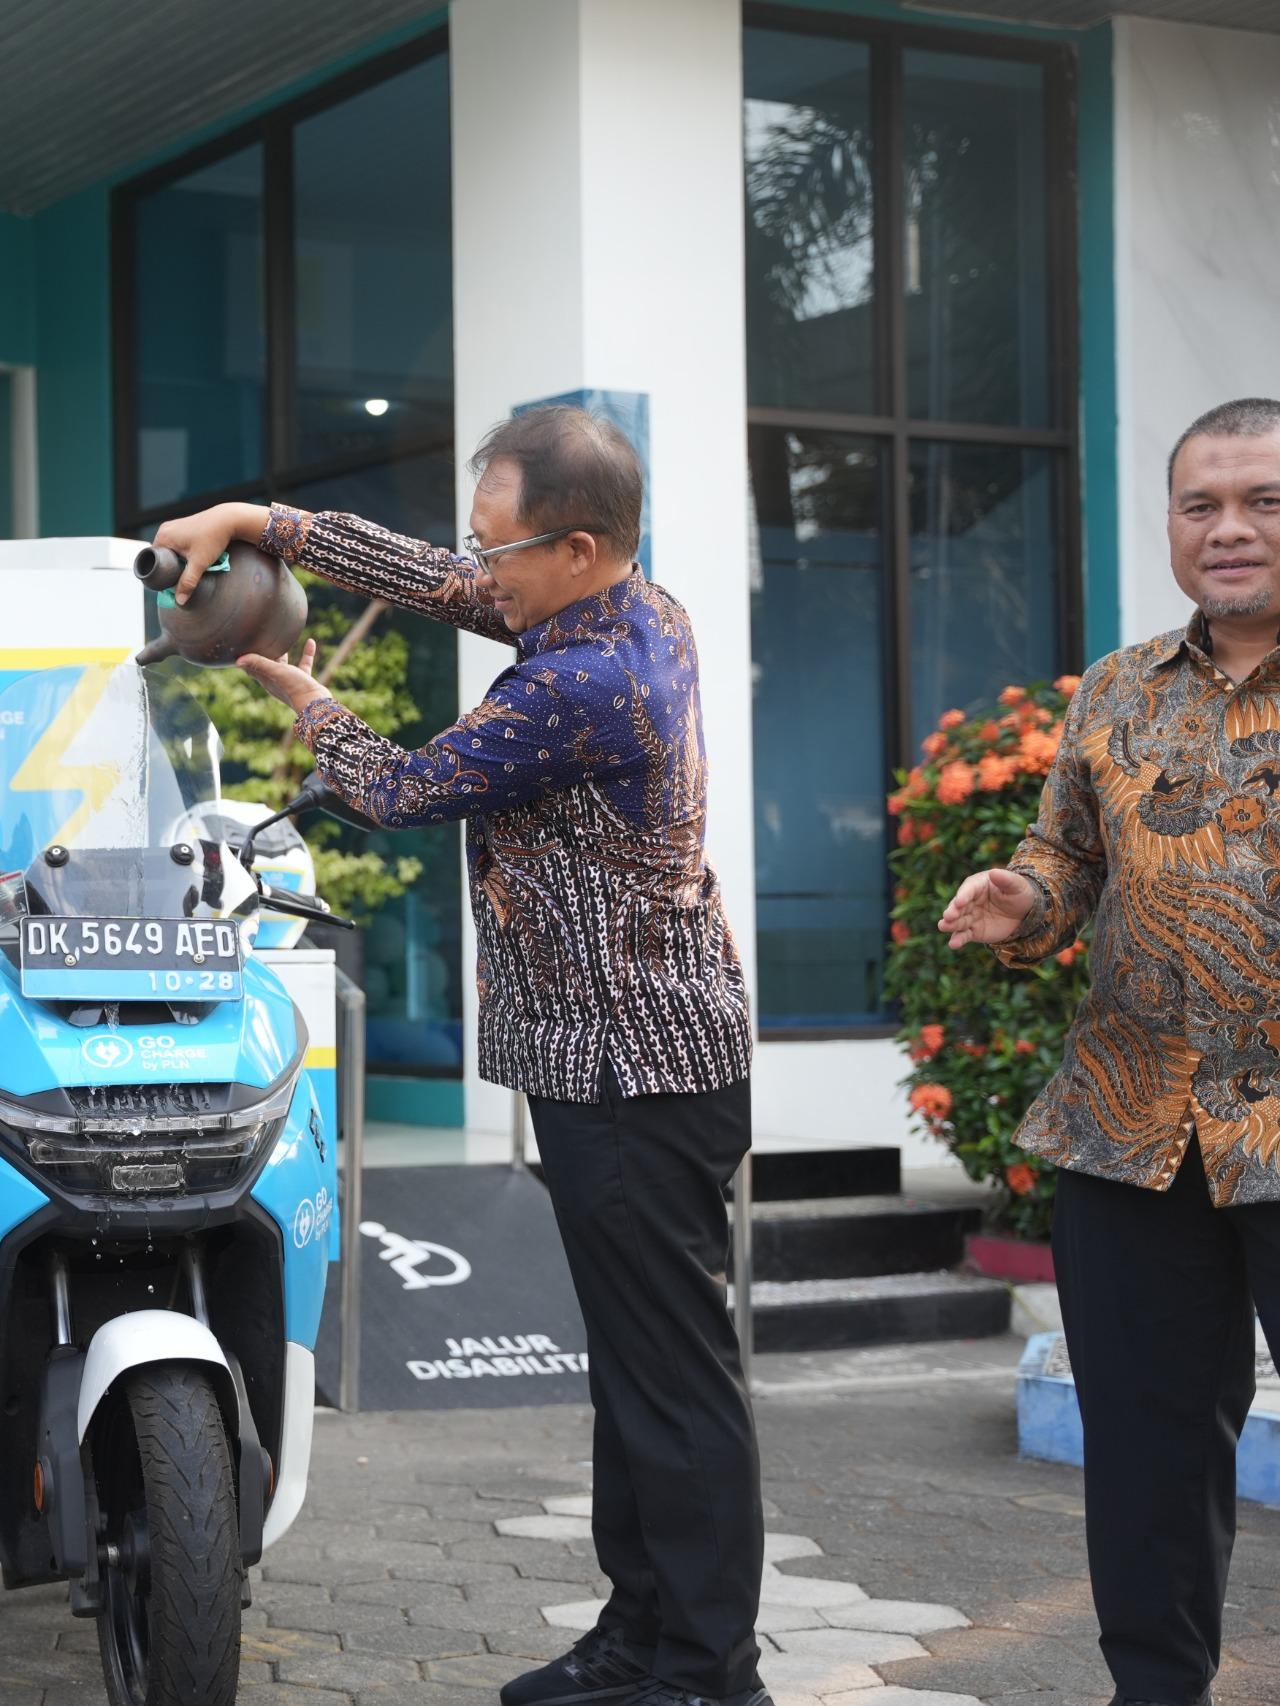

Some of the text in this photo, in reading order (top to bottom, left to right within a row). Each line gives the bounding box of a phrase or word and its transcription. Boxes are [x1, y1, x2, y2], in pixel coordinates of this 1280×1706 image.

[28, 922, 70, 955] DK
[80, 922, 163, 955] 5649
[137, 1036, 175, 1049] GO
[141, 1048, 208, 1059] CHARGE
[143, 1058, 190, 1071] by PLN
[445, 1334, 561, 1357] JALUR
